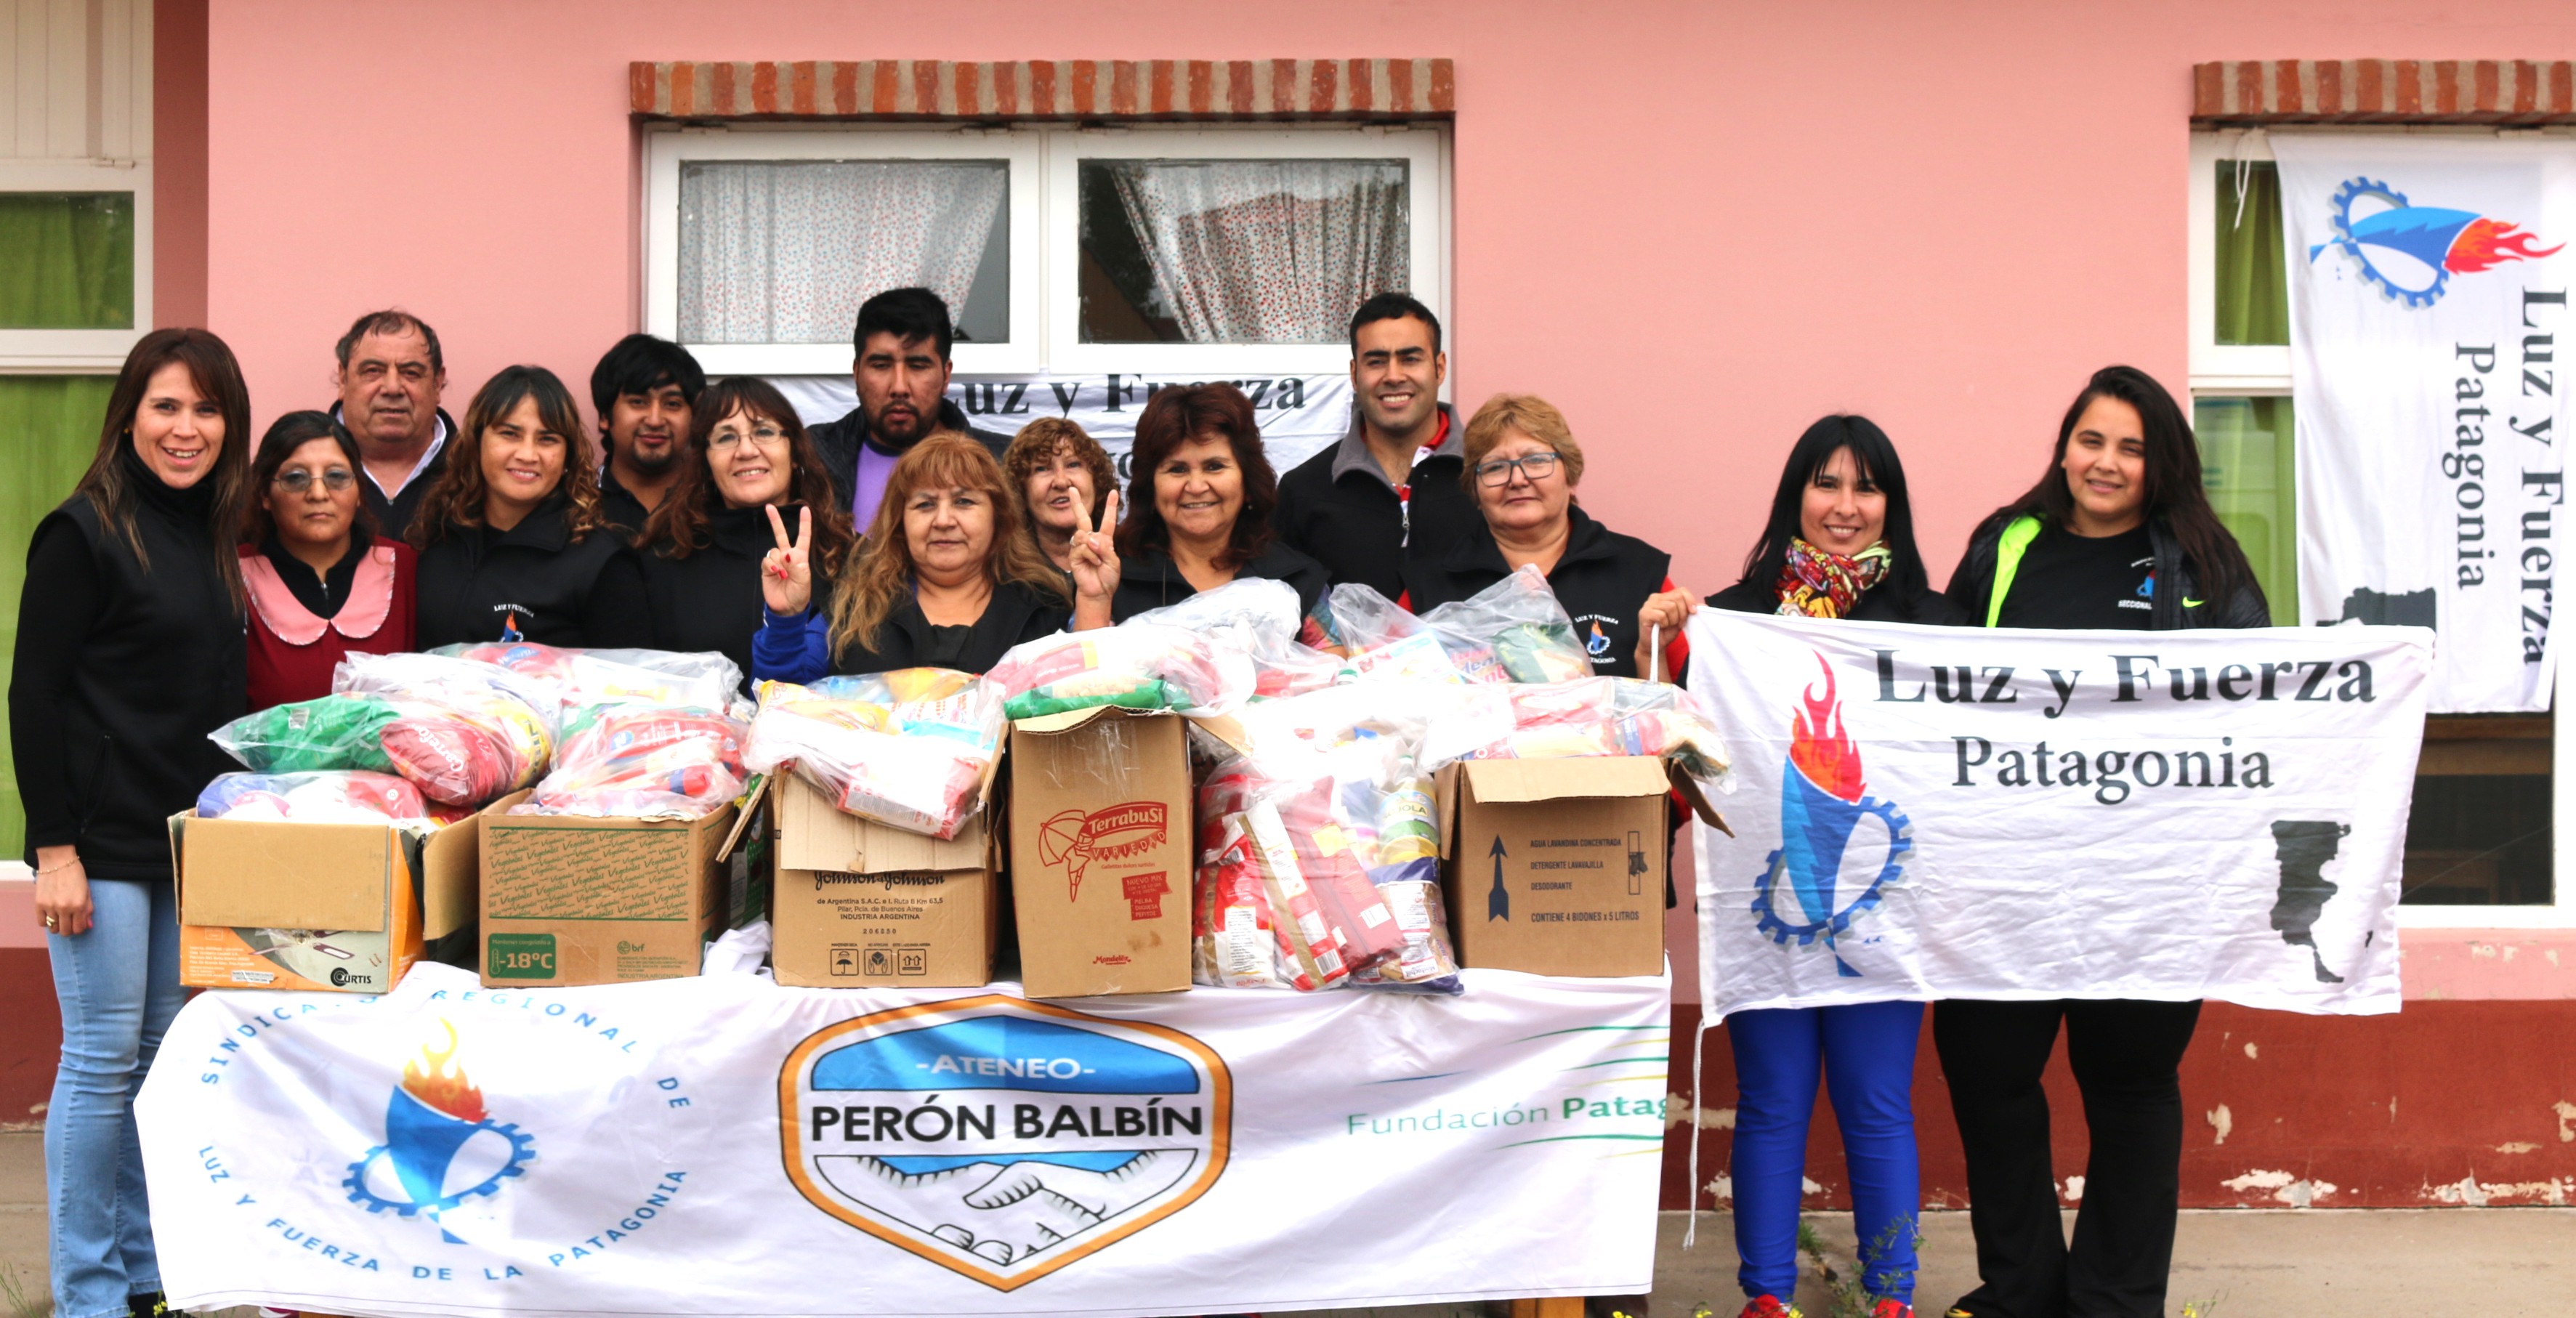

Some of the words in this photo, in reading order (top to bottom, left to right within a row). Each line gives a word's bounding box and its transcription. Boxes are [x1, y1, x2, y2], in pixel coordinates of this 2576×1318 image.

[2522, 286, 2567, 397] Luz
[954, 383, 1030, 415] uz
[2509, 414, 2553, 448] y
[2442, 341, 2496, 589] Patagonia
[2521, 466, 2564, 664] Fuerza
[1873, 648, 2018, 703] Luz
[2042, 668, 2083, 719] y
[2110, 654, 2377, 703] Fuerza
[1951, 735, 2275, 805] Patagonia
[1093, 831, 1166, 858] VARIEDAD
[1126, 877, 1150, 886] NUEVO
[1531, 913, 1564, 923] CONTIENE
[1566, 913, 1571, 922] 4
[1572, 913, 1602, 922] BIDONES
[1609, 913, 1614, 921] 5
[1615, 912, 1639, 921] LITROS
[631, 943, 645, 952] brf
[201, 996, 378, 1085] SINDICA
[430, 988, 639, 1054] REGIONAL
[657, 1077, 691, 1111] DE
[812, 1093, 995, 1142] PERÓN
[1014, 1097, 1203, 1139] BALBÍN
[1348, 1101, 1549, 1135] Fundación
[198, 1145, 230, 1185] LUZ
[235, 1194, 257, 1208] Y
[267, 1218, 380, 1272] FUERZA
[412, 1266, 452, 1281] DE
[483, 1265, 523, 1282] LA
[549, 1171, 687, 1267] PATAGONIA
